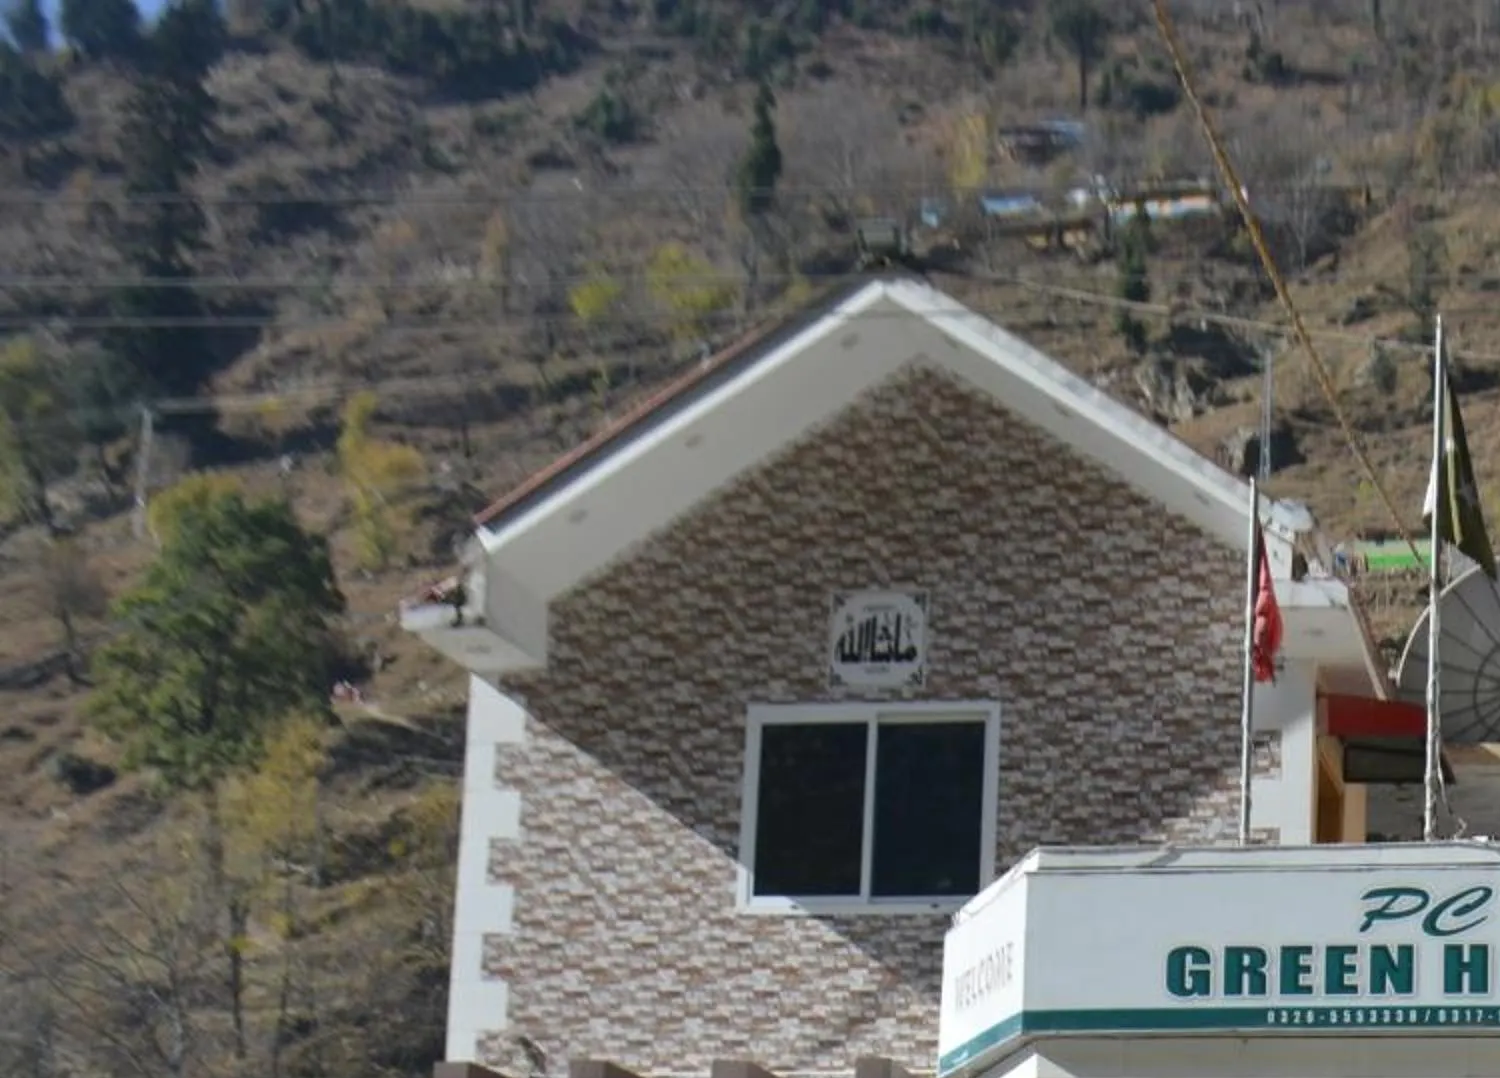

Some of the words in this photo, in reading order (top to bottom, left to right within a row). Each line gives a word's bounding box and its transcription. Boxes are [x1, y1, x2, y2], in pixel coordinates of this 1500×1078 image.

[1359, 886, 1493, 936] PC
[956, 941, 1014, 1013] WELCOME
[1166, 944, 1415, 997] GREEN
